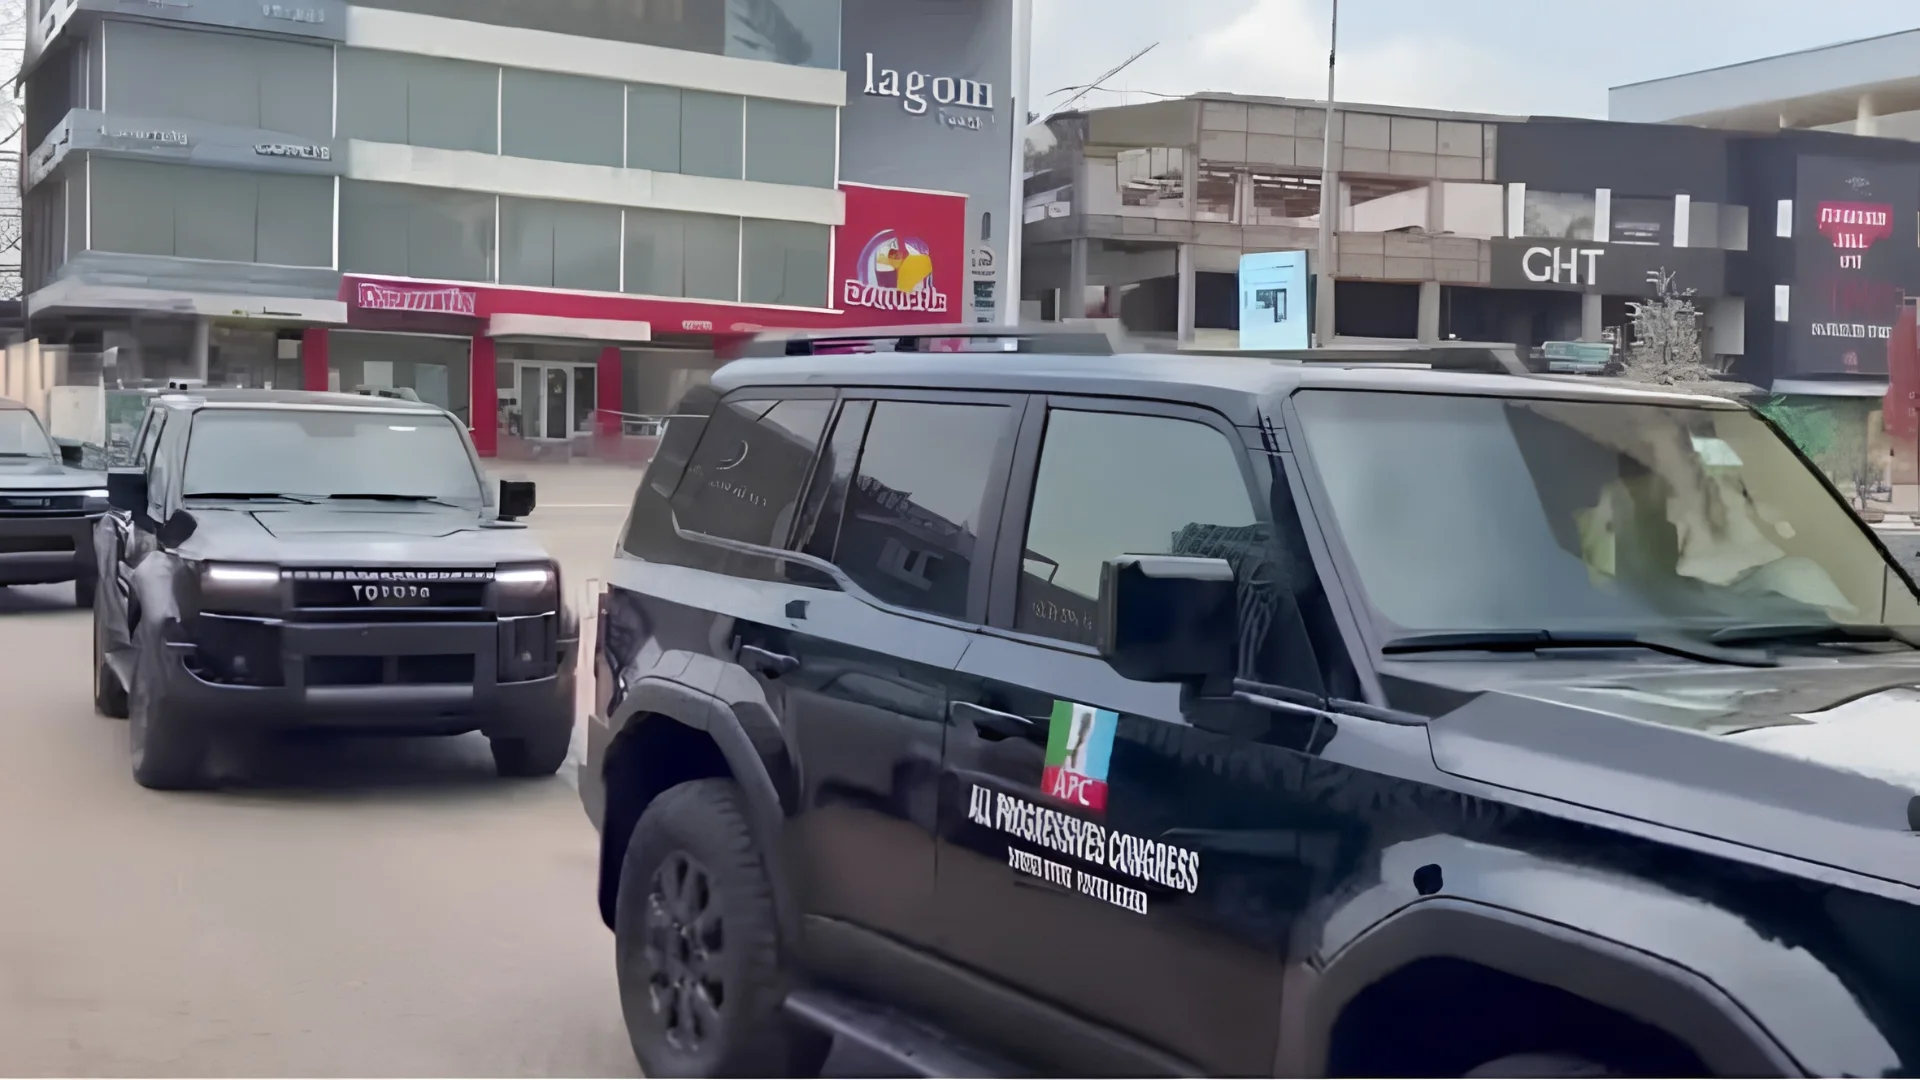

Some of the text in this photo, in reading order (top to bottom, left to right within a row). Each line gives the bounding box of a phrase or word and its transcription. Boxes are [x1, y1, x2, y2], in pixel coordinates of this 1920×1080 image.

[864, 52, 993, 114] lagom
[1522, 247, 1604, 285] GHT
[1052, 767, 1093, 806] APC
[1108, 830, 1199, 894] CONGRESS
